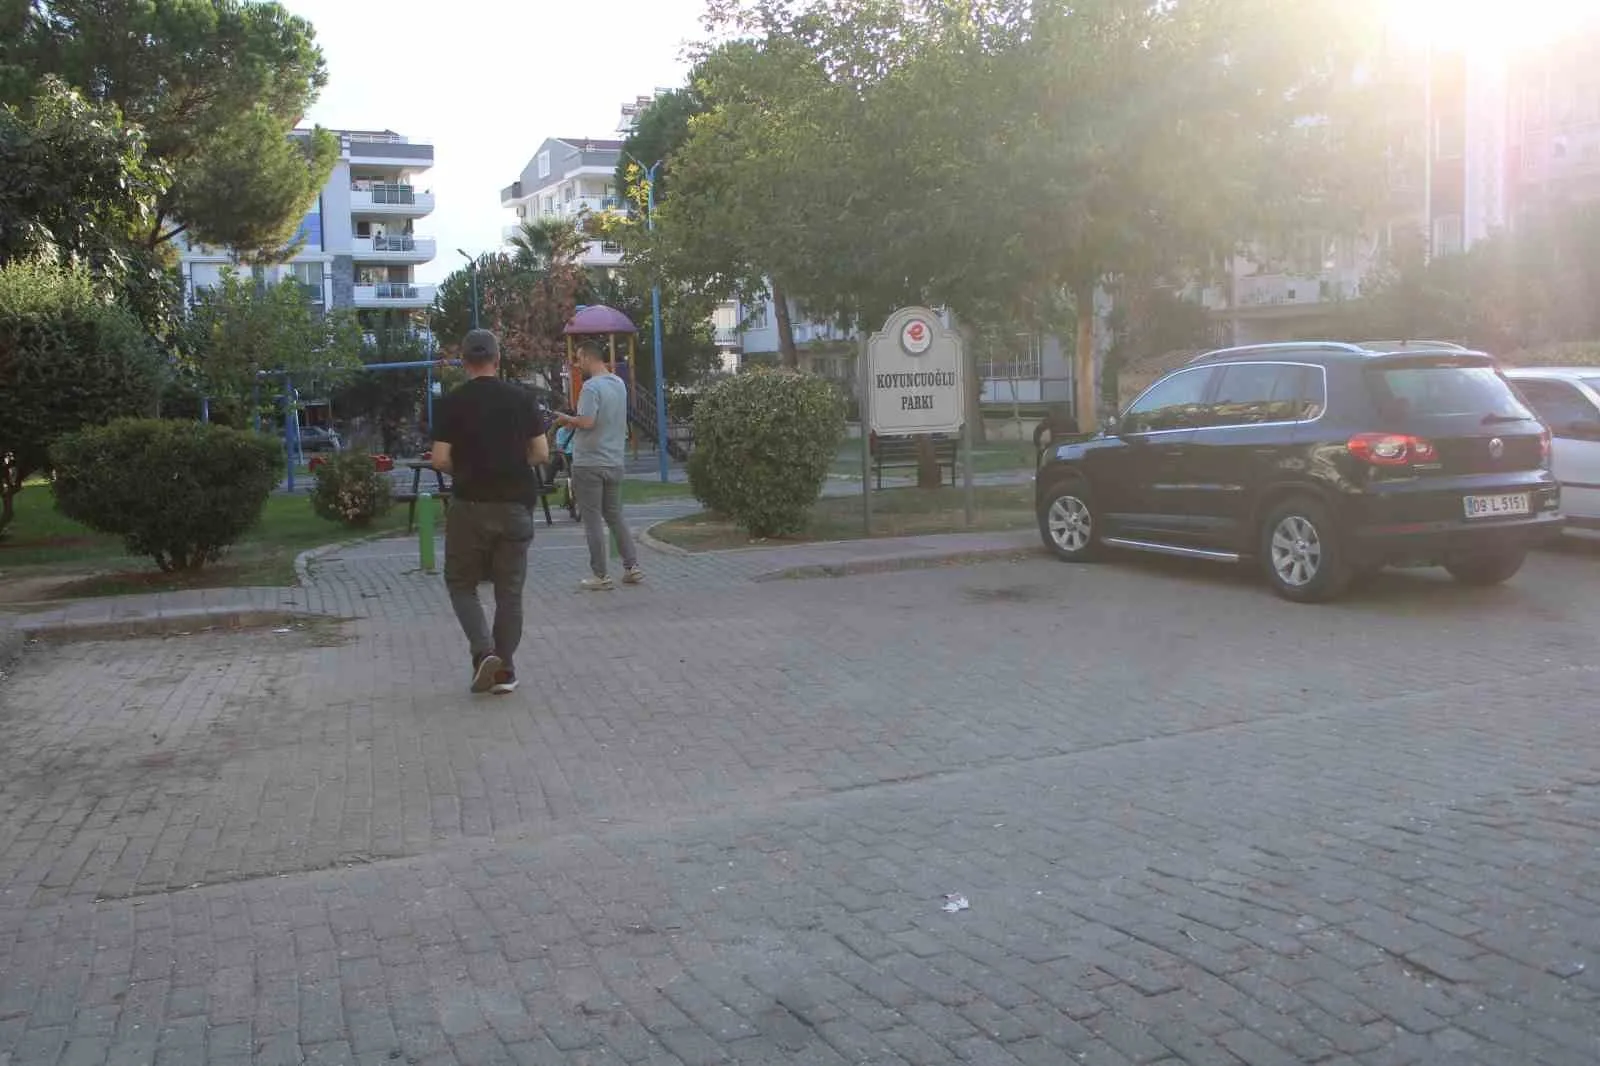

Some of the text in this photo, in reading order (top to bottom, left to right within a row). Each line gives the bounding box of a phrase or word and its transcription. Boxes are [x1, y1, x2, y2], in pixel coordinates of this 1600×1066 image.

[876, 370, 955, 389] KOYUNCUOĞLU
[901, 395, 934, 410] PARKI
[1474, 495, 1526, 512] 09 L 5151
